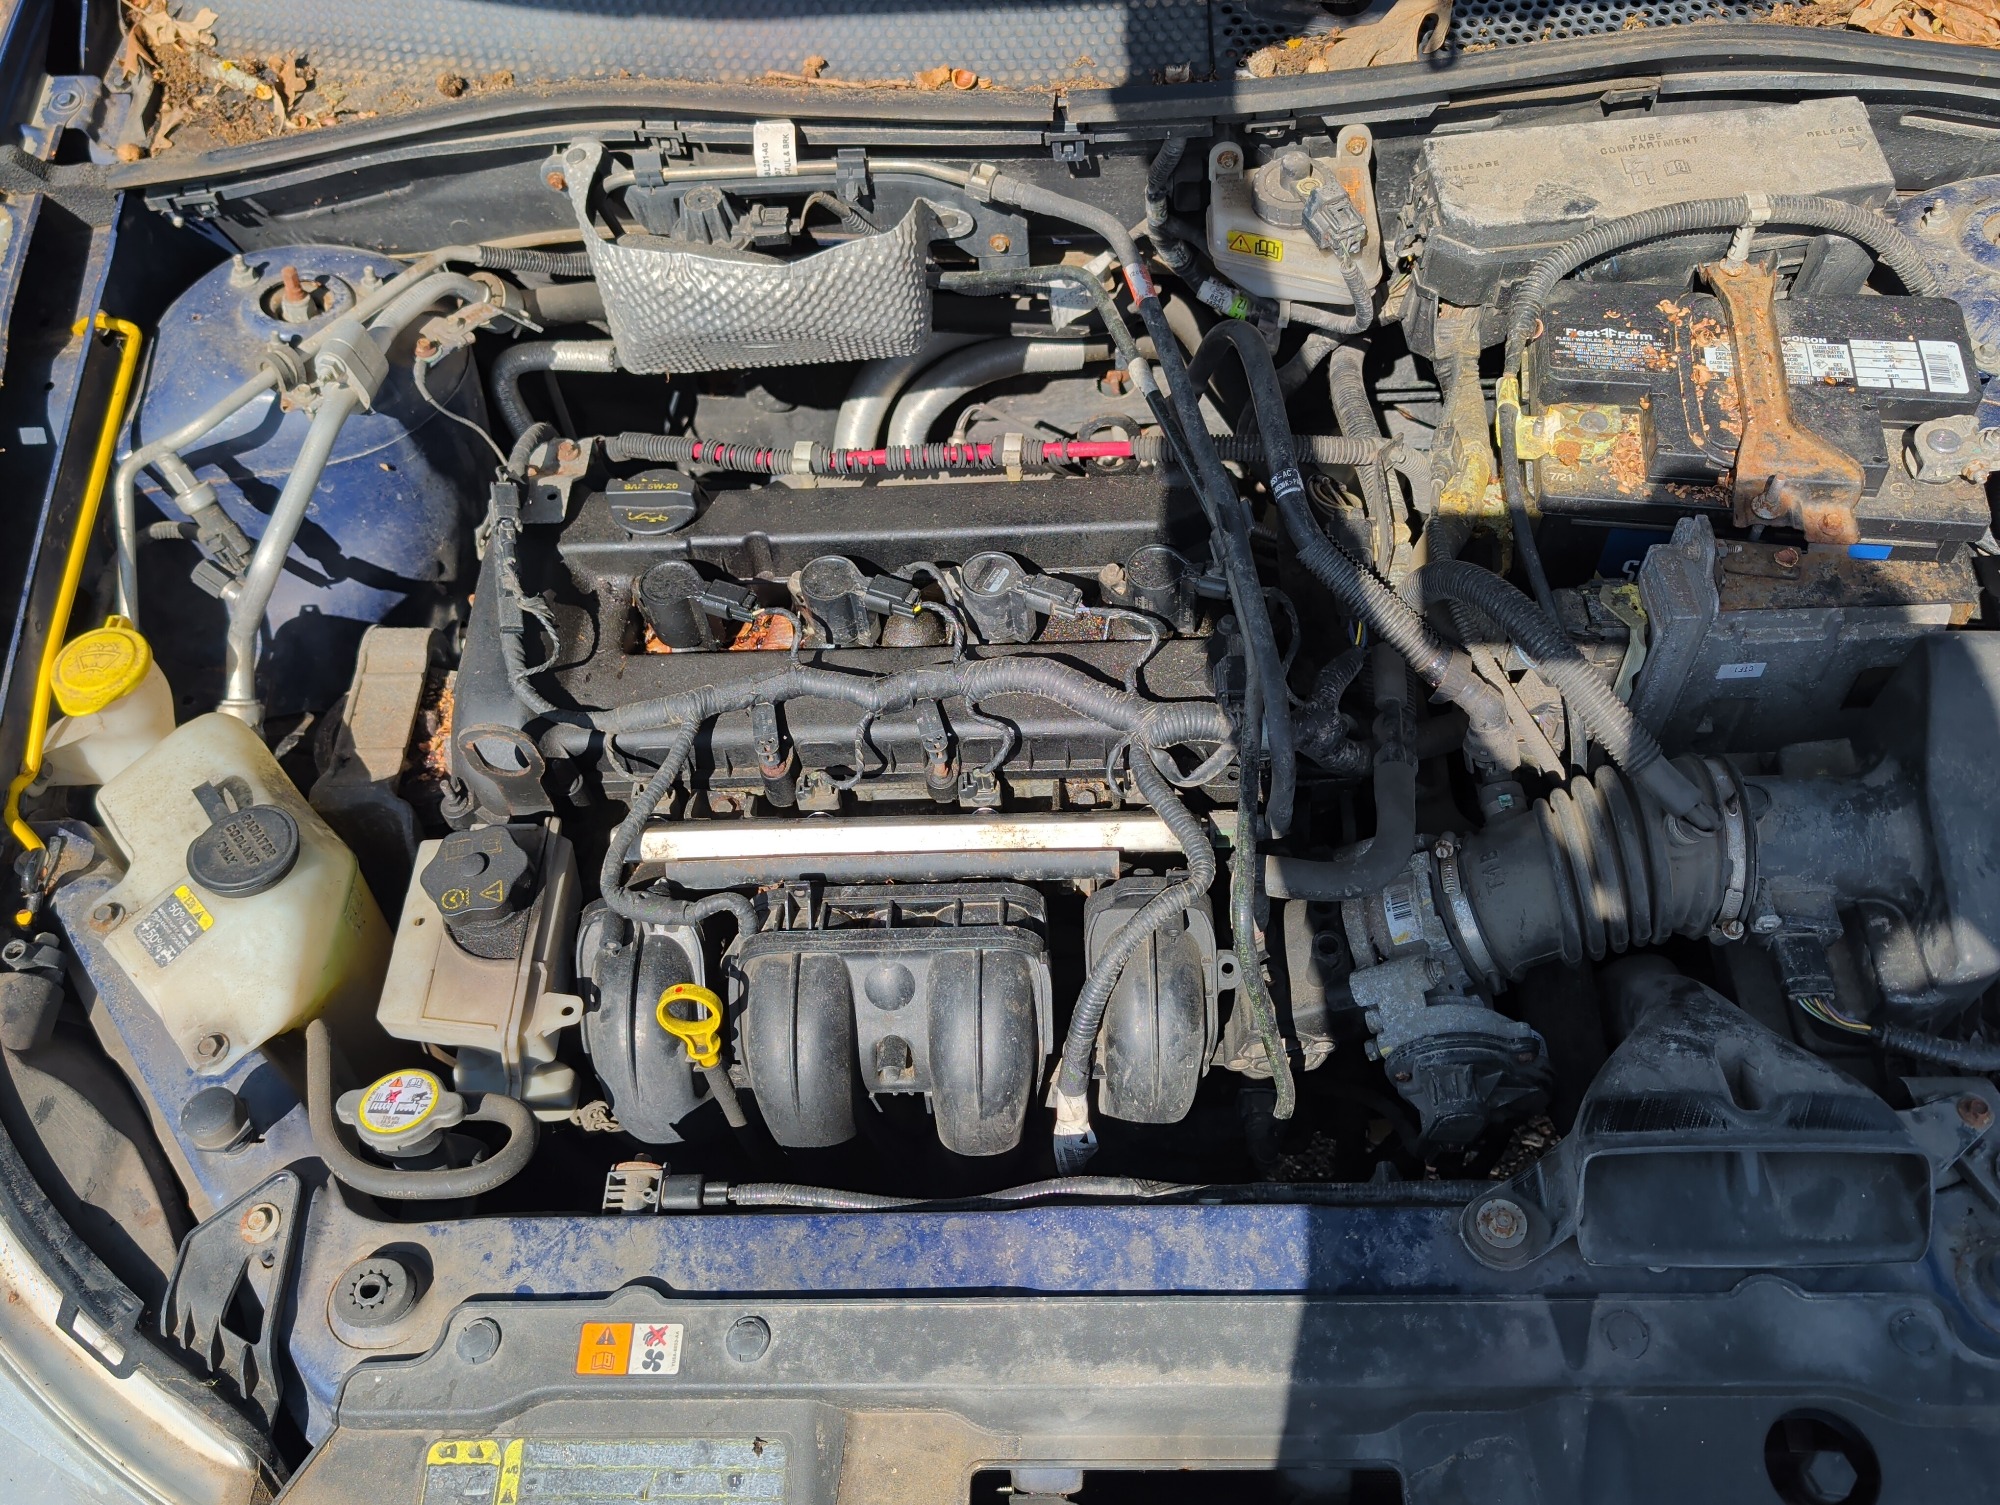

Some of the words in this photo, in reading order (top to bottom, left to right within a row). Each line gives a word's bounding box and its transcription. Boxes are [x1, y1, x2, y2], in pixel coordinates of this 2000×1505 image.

[1631, 132, 1664, 142] FUSE
[1806, 125, 1863, 138] RELEASE
[1600, 136, 1698, 155] COMPARTMENT
[1443, 160, 1500, 173] RELEASE
[1618, 331, 1653, 340] Farm
[1784, 336, 1827, 344] POISON
[1550, 472, 1573, 481] 7/21
[240, 814, 277, 858] RADIATOR
[226, 824, 260, 865] COOLANT
[168, 902, 188, 924] 50%
